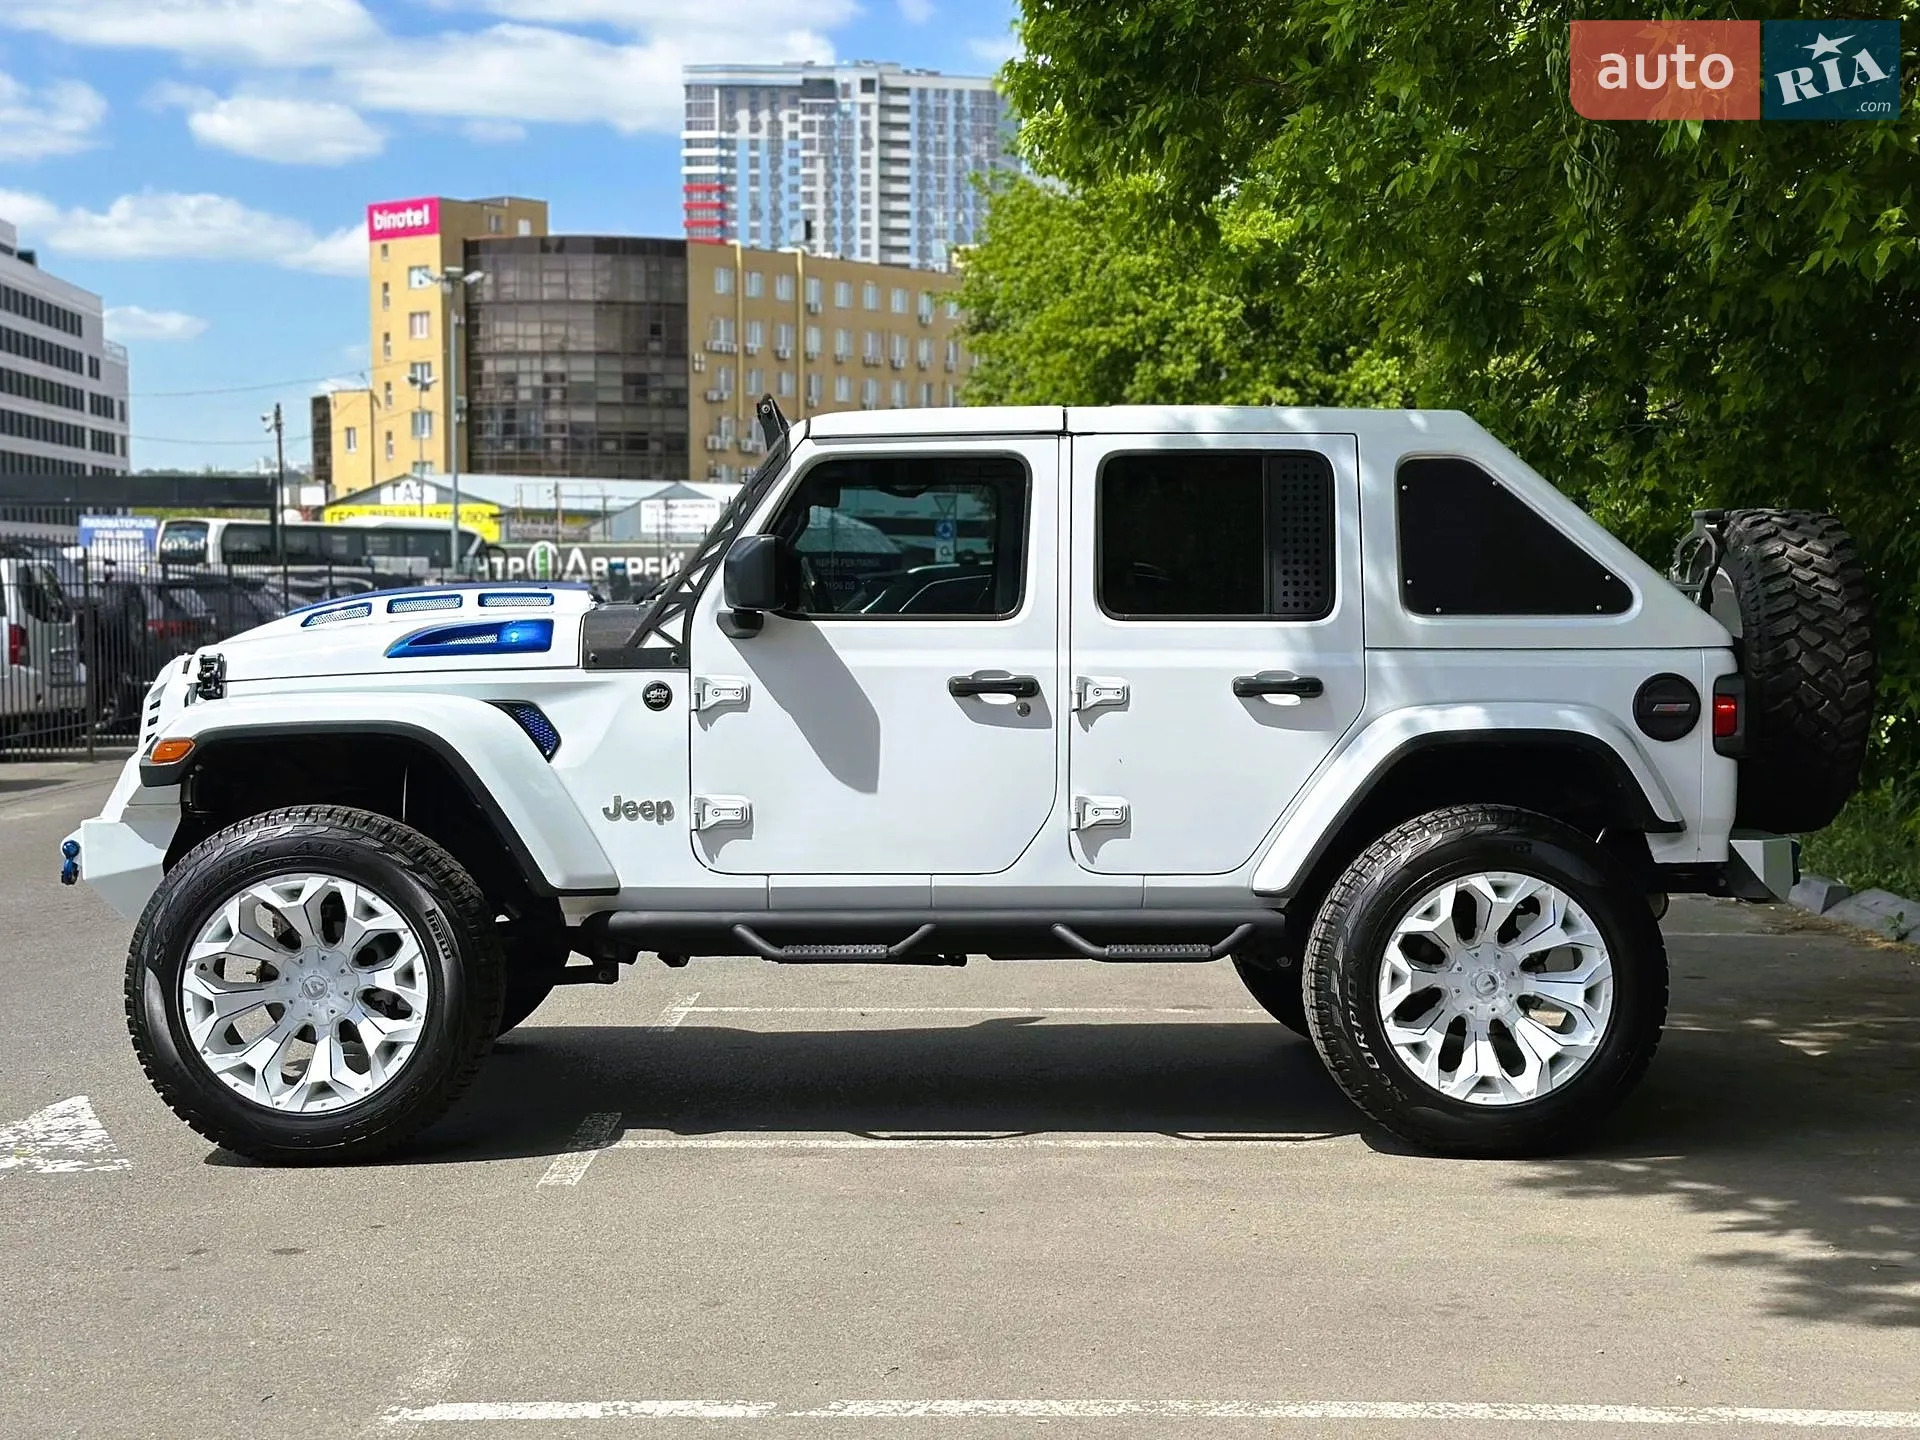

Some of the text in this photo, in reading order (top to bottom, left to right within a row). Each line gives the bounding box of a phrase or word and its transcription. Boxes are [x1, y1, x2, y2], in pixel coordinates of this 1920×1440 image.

[373, 204, 429, 231] binotel
[602, 795, 675, 826] Jeep
[425, 908, 455, 961] PIRELLI
